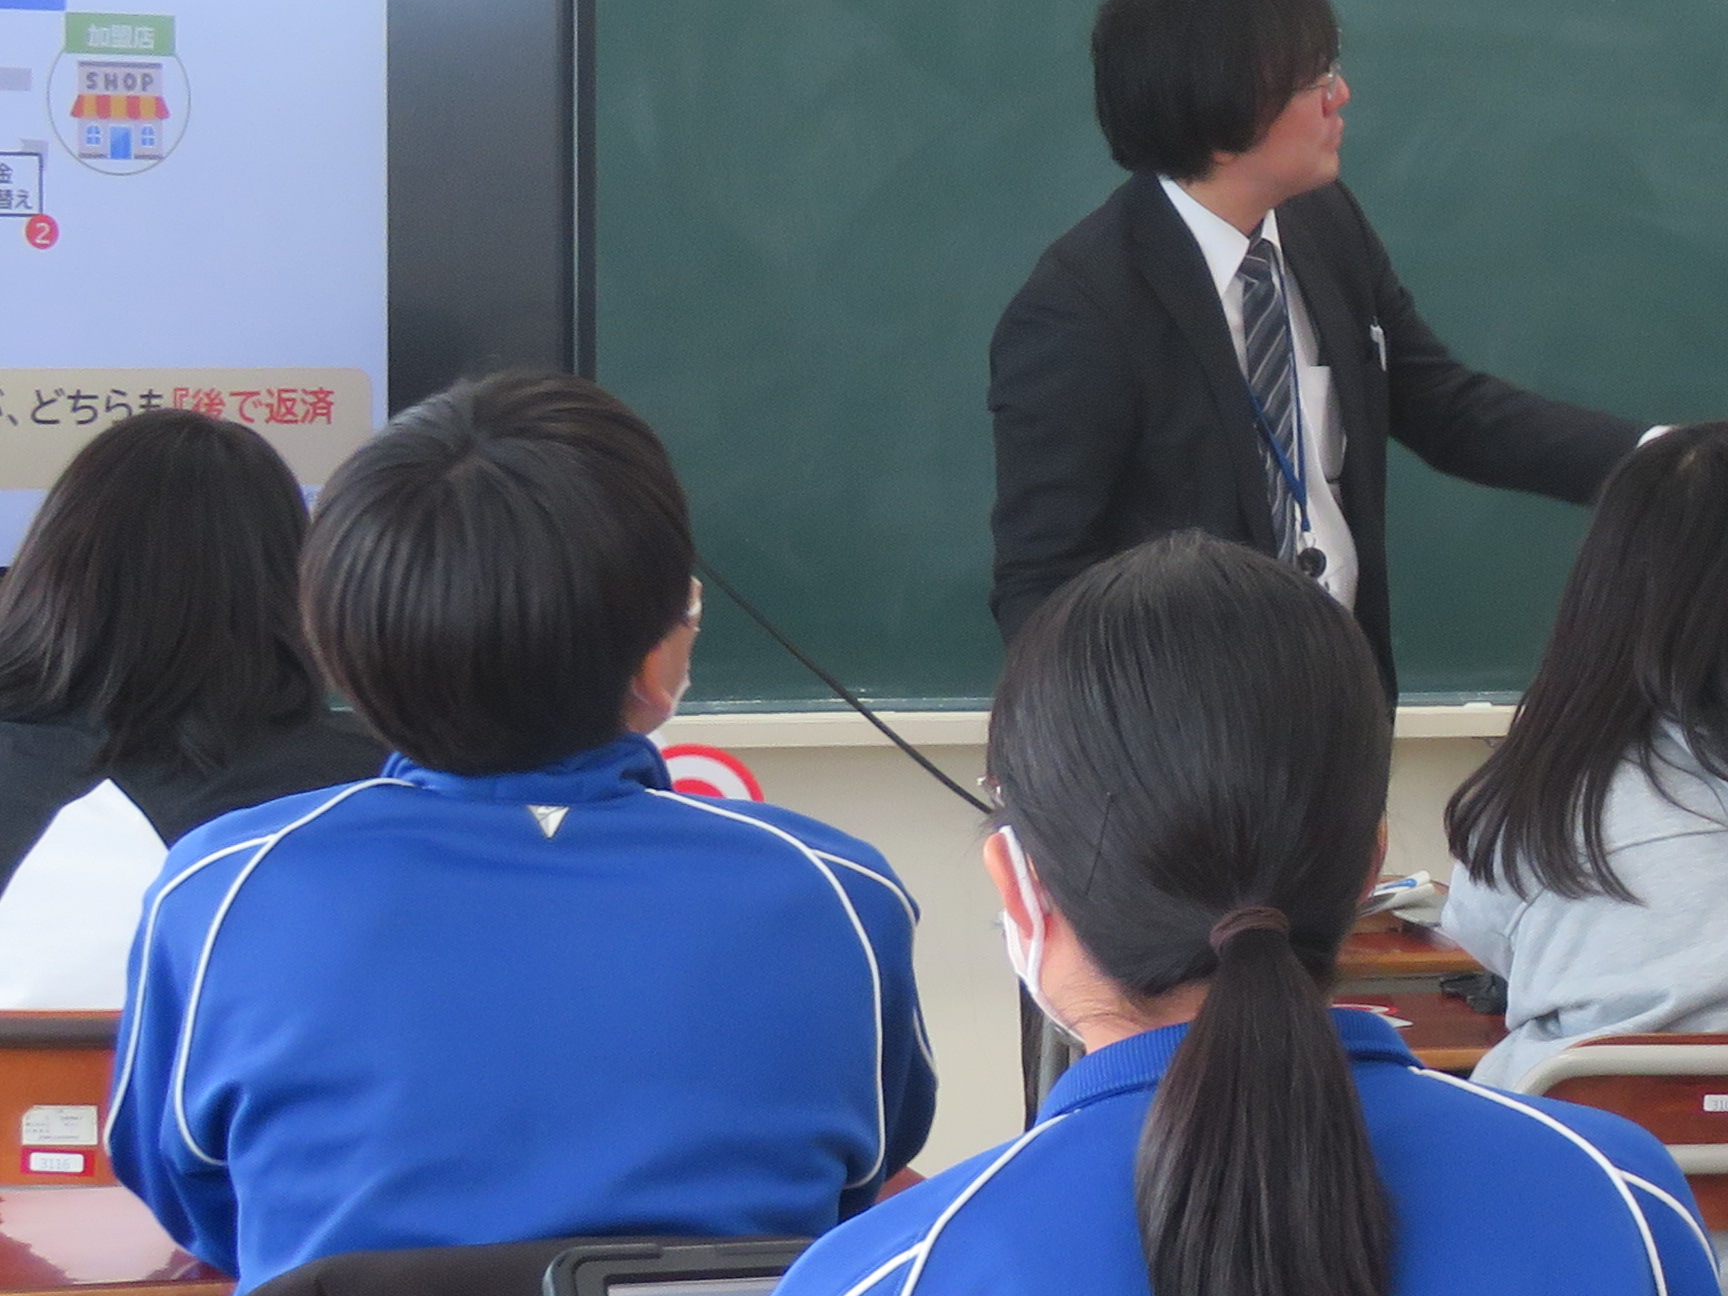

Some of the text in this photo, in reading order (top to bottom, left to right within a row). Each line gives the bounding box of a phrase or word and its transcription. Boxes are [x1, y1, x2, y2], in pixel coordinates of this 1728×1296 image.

[87, 24, 155, 49] 加盟店
[86, 72, 155, 93] SHOP
[34, 222, 51, 245] 2
[0, 386, 336, 426] 、どちらも『後で返済
